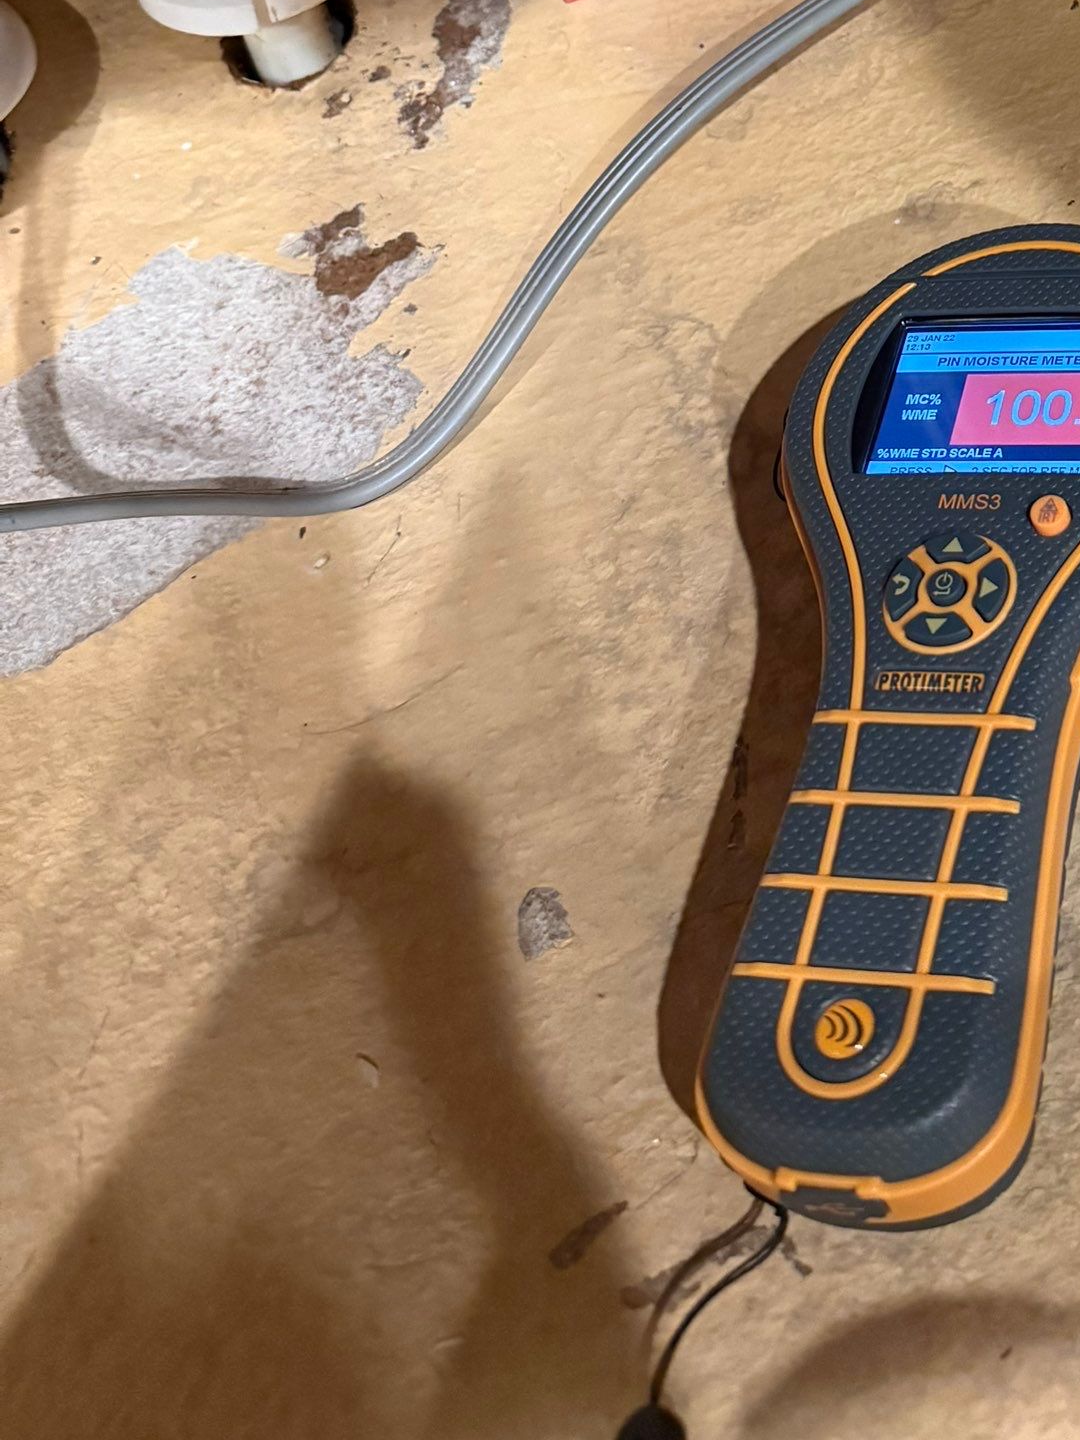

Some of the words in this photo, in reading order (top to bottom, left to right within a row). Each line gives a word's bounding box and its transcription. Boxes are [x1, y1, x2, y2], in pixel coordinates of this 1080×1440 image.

[937, 357, 960, 367] PIN
[964, 356, 1038, 367] MOISTURE
[905, 393, 942, 406] MC%
[901, 409, 937, 421] WME
[877, 448, 920, 458] %WME
[921, 448, 947, 458] STD
[949, 448, 993, 458] SCALE
[993, 448, 1003, 458] A
[937, 494, 1001, 510] MMS3
[878, 672, 982, 693] PROTIMETER
